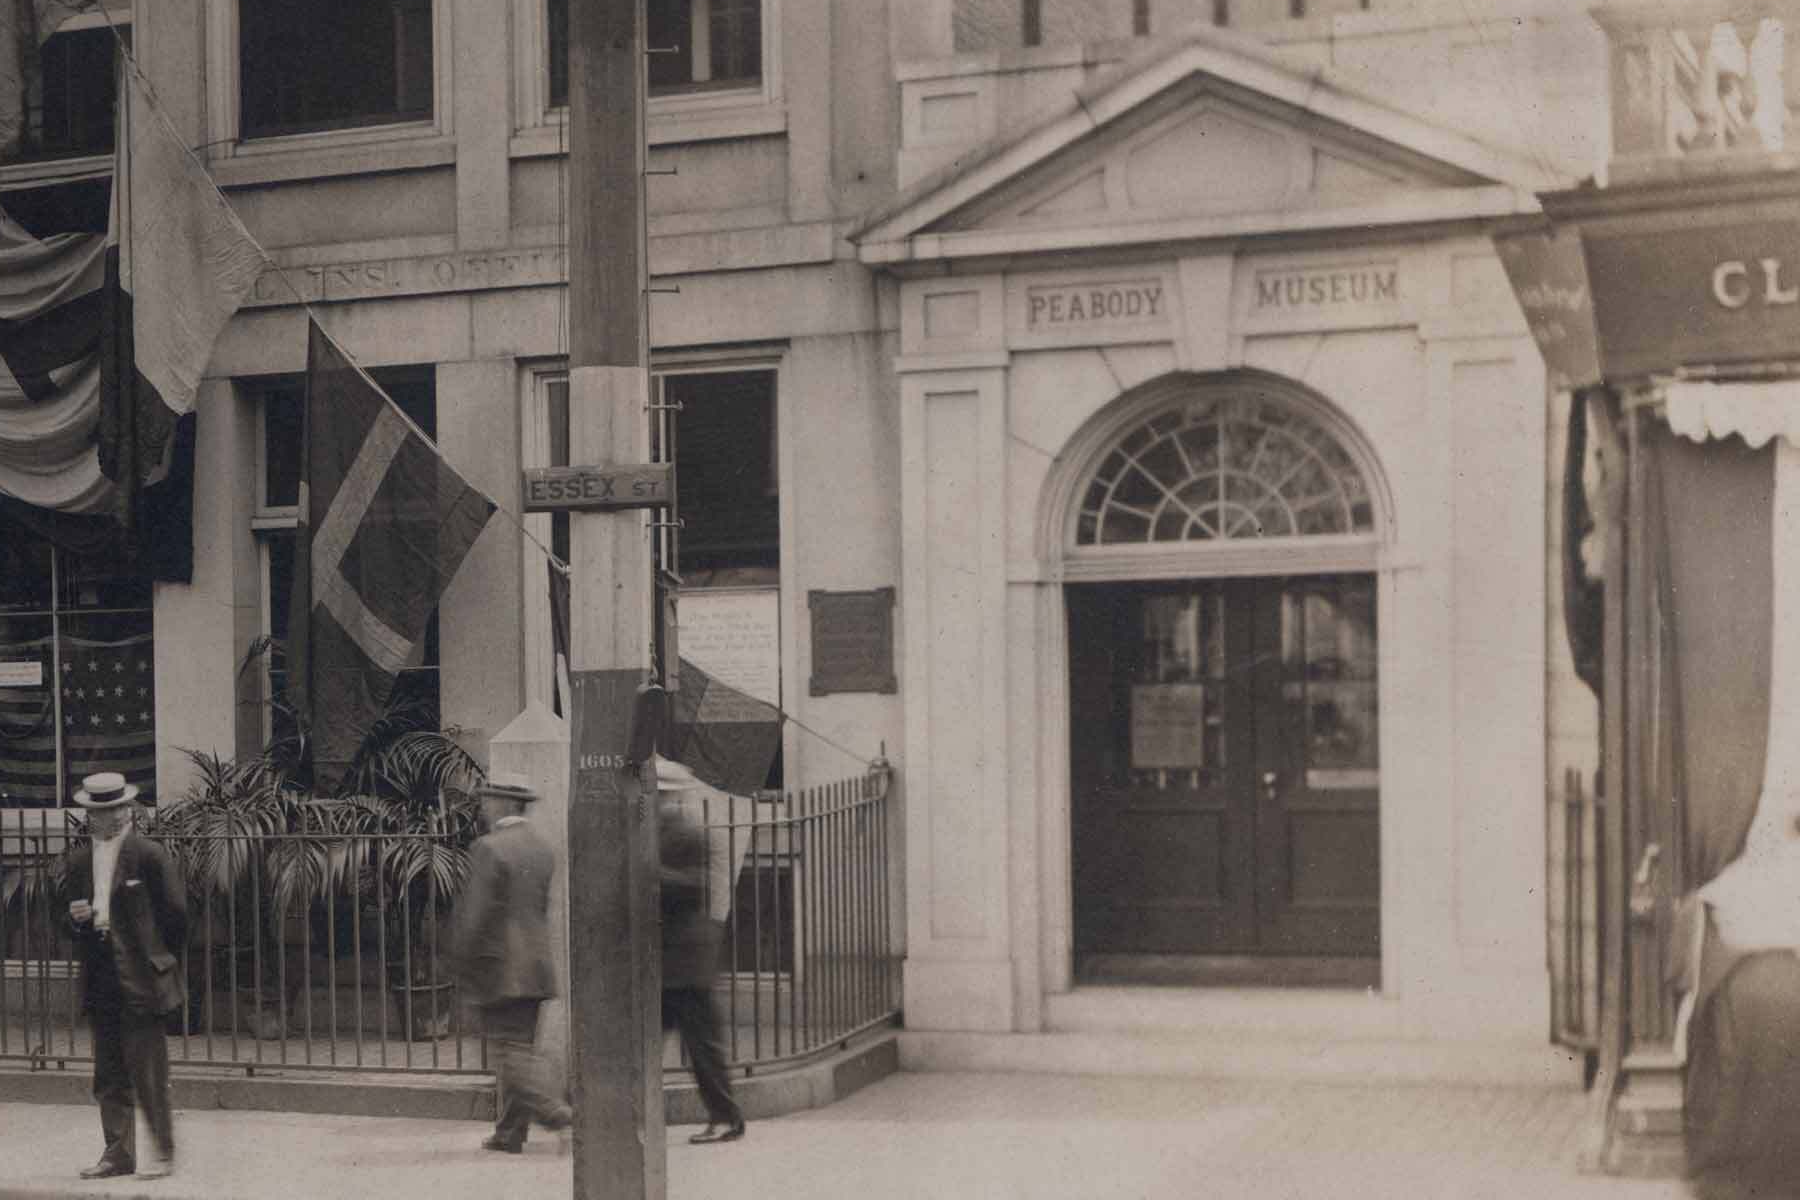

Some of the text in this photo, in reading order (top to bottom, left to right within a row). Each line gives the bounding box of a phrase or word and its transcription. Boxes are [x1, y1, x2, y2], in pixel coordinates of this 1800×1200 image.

[1027, 268, 1398, 325] PEABODY MUSEUM
[530, 476, 659, 502] ESSEX ST
